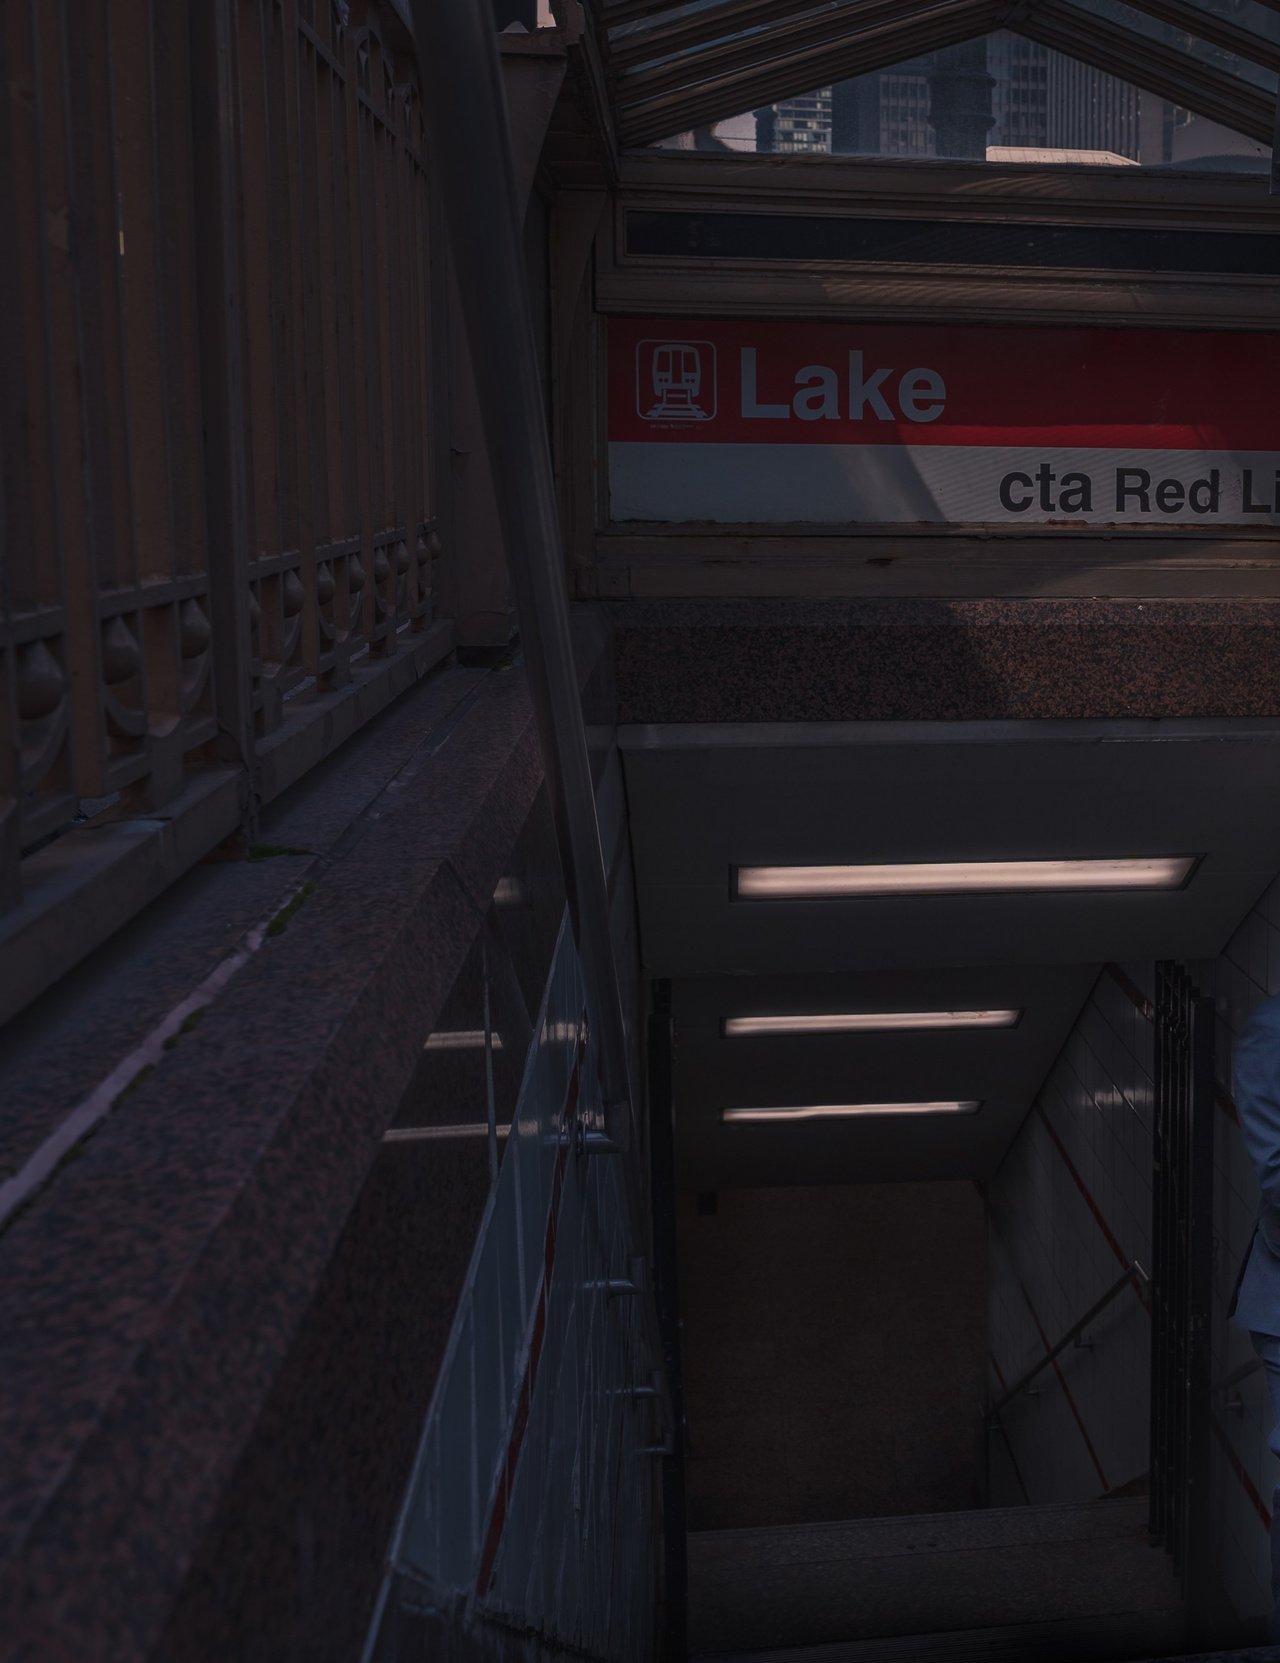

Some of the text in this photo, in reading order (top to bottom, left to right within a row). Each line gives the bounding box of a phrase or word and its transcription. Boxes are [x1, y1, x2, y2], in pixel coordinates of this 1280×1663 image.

[740, 347, 947, 423] Lake
[999, 463, 1094, 514] cta
[1115, 468, 1221, 514] Red
